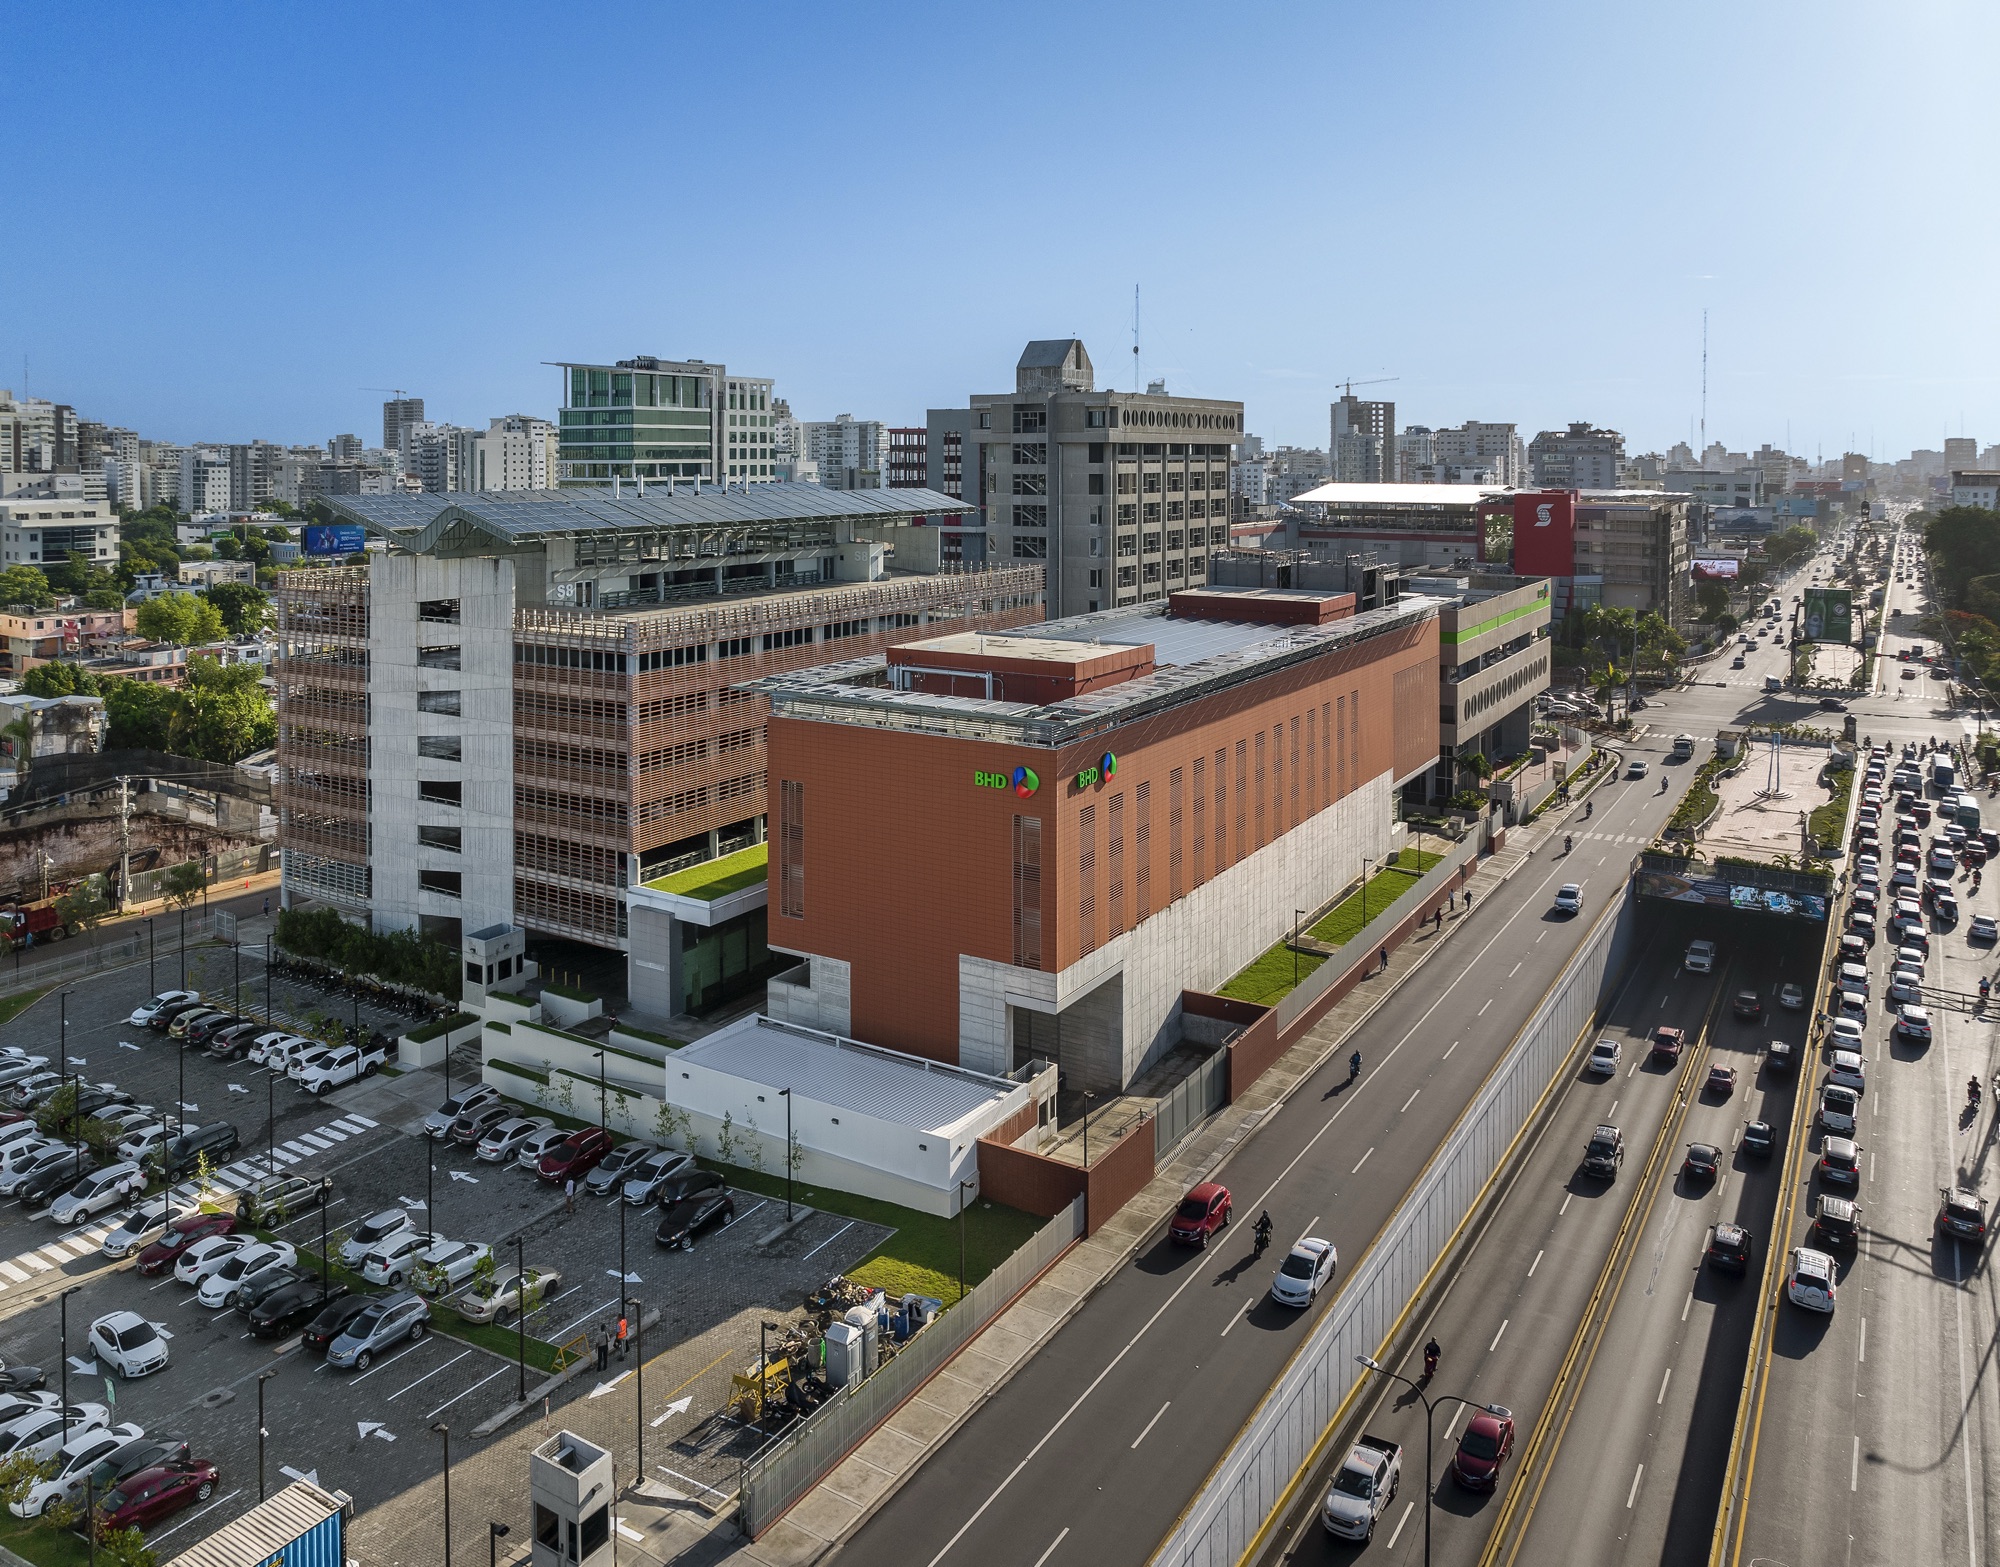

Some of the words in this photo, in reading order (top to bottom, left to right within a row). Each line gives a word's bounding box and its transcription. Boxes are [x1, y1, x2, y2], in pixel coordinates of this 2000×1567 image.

[855, 550, 868, 561] S8
[557, 584, 573, 597] S8
[974, 771, 1008, 789] BHD
[1078, 767, 1099, 788] BHD
